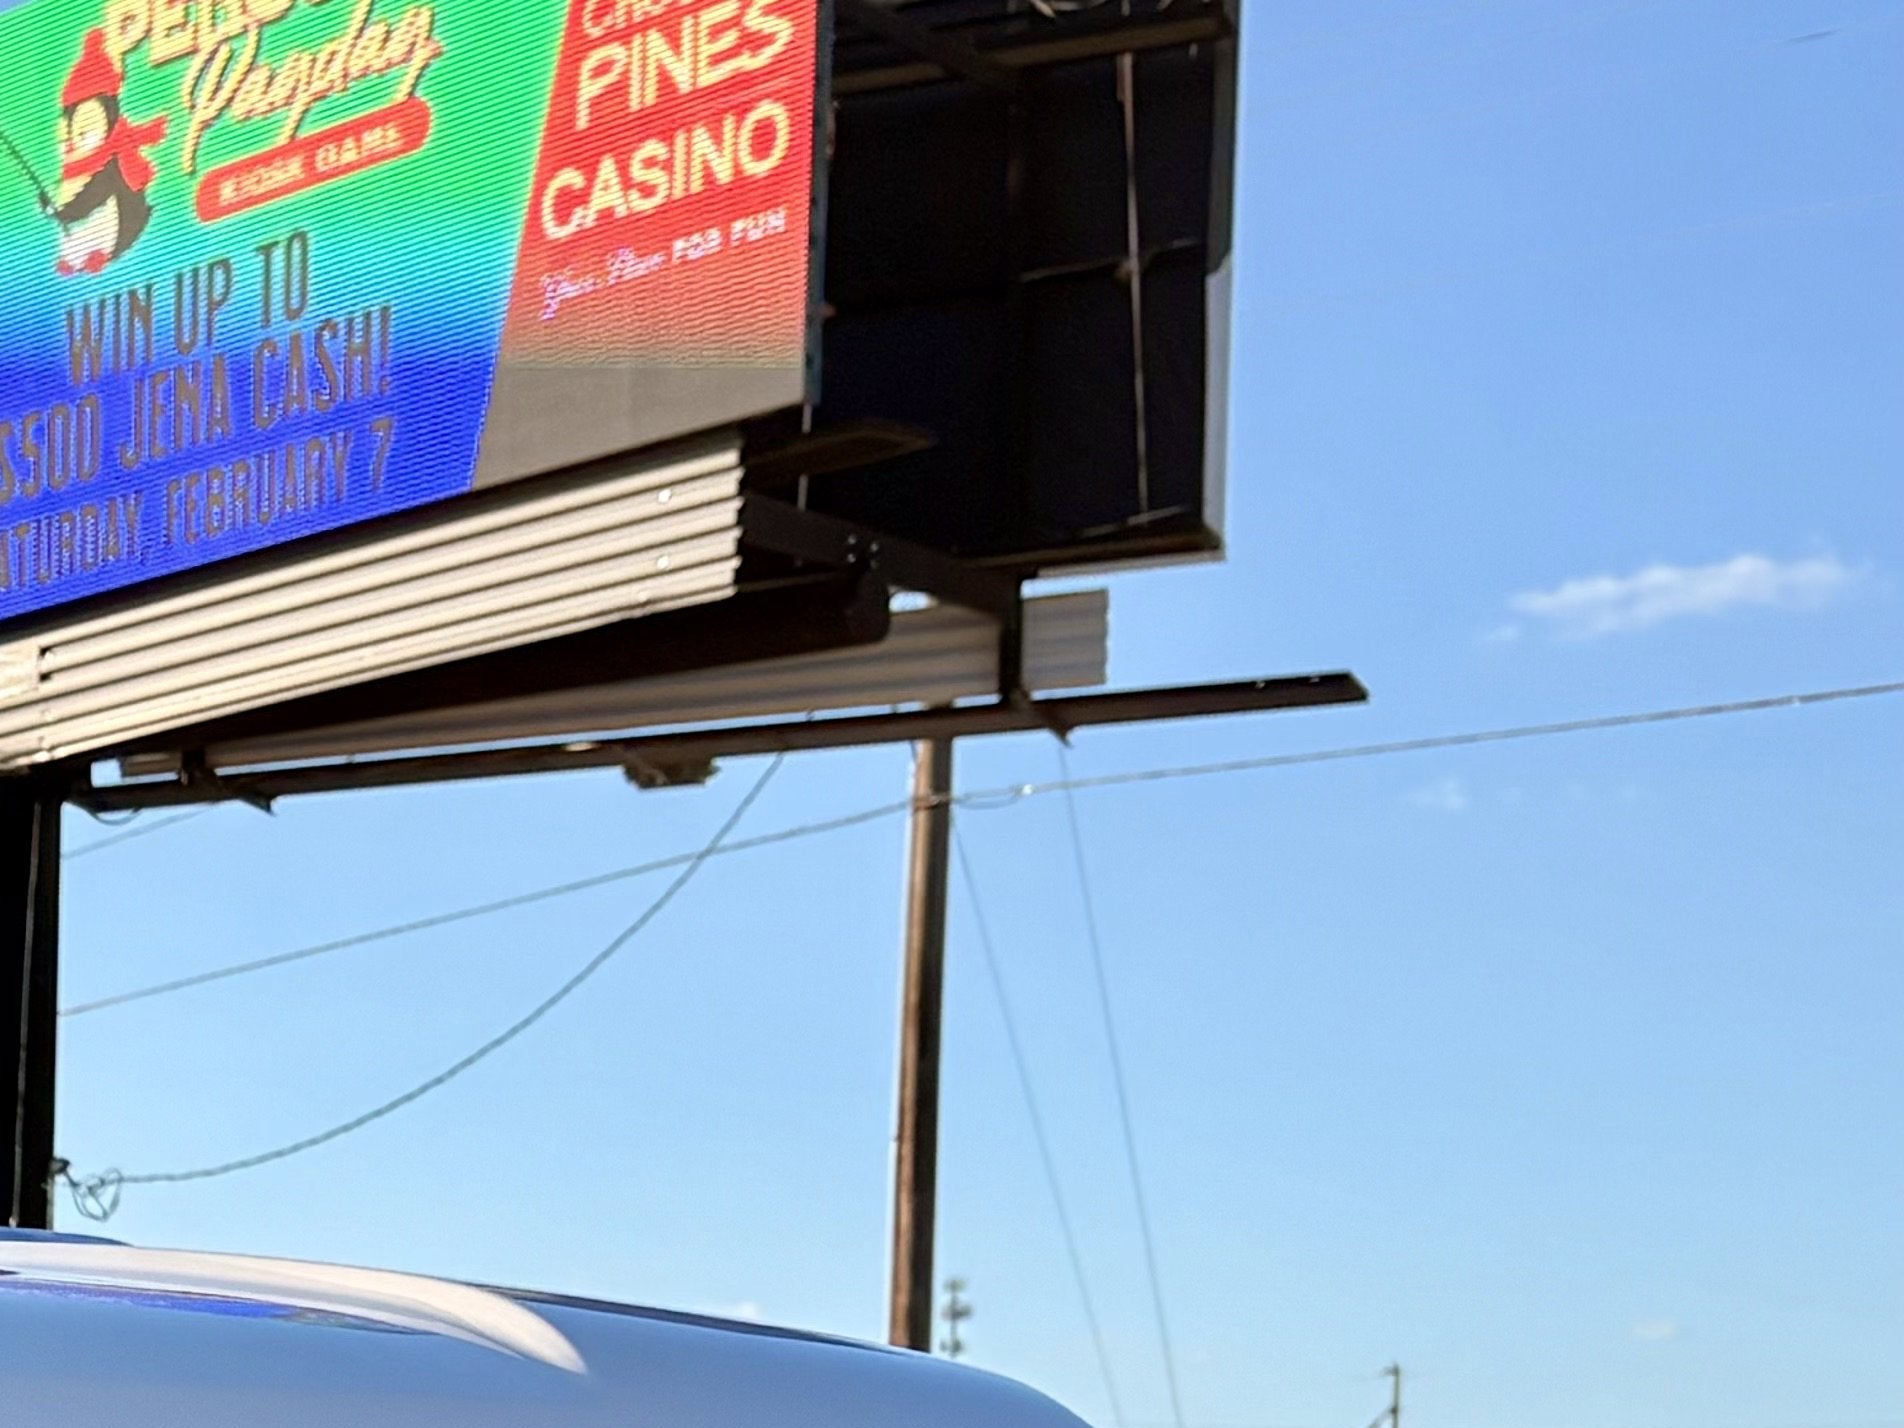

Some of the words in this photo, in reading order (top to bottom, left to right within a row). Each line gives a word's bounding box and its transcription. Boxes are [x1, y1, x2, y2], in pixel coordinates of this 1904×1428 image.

[575, 0, 793, 131] PINES
[313, 123, 403, 172] GAME
[542, 99, 791, 240] CASINO
[730, 205, 787, 246] FUN
[65, 282, 155, 386] WIN
[172, 257, 233, 355] UP
[256, 229, 311, 329] TO
[119, 352, 231, 469] JENA
[252, 304, 391, 431] CASH!
[164, 428, 352, 547] FEBRUARY
[370, 416, 393, 491] 7
